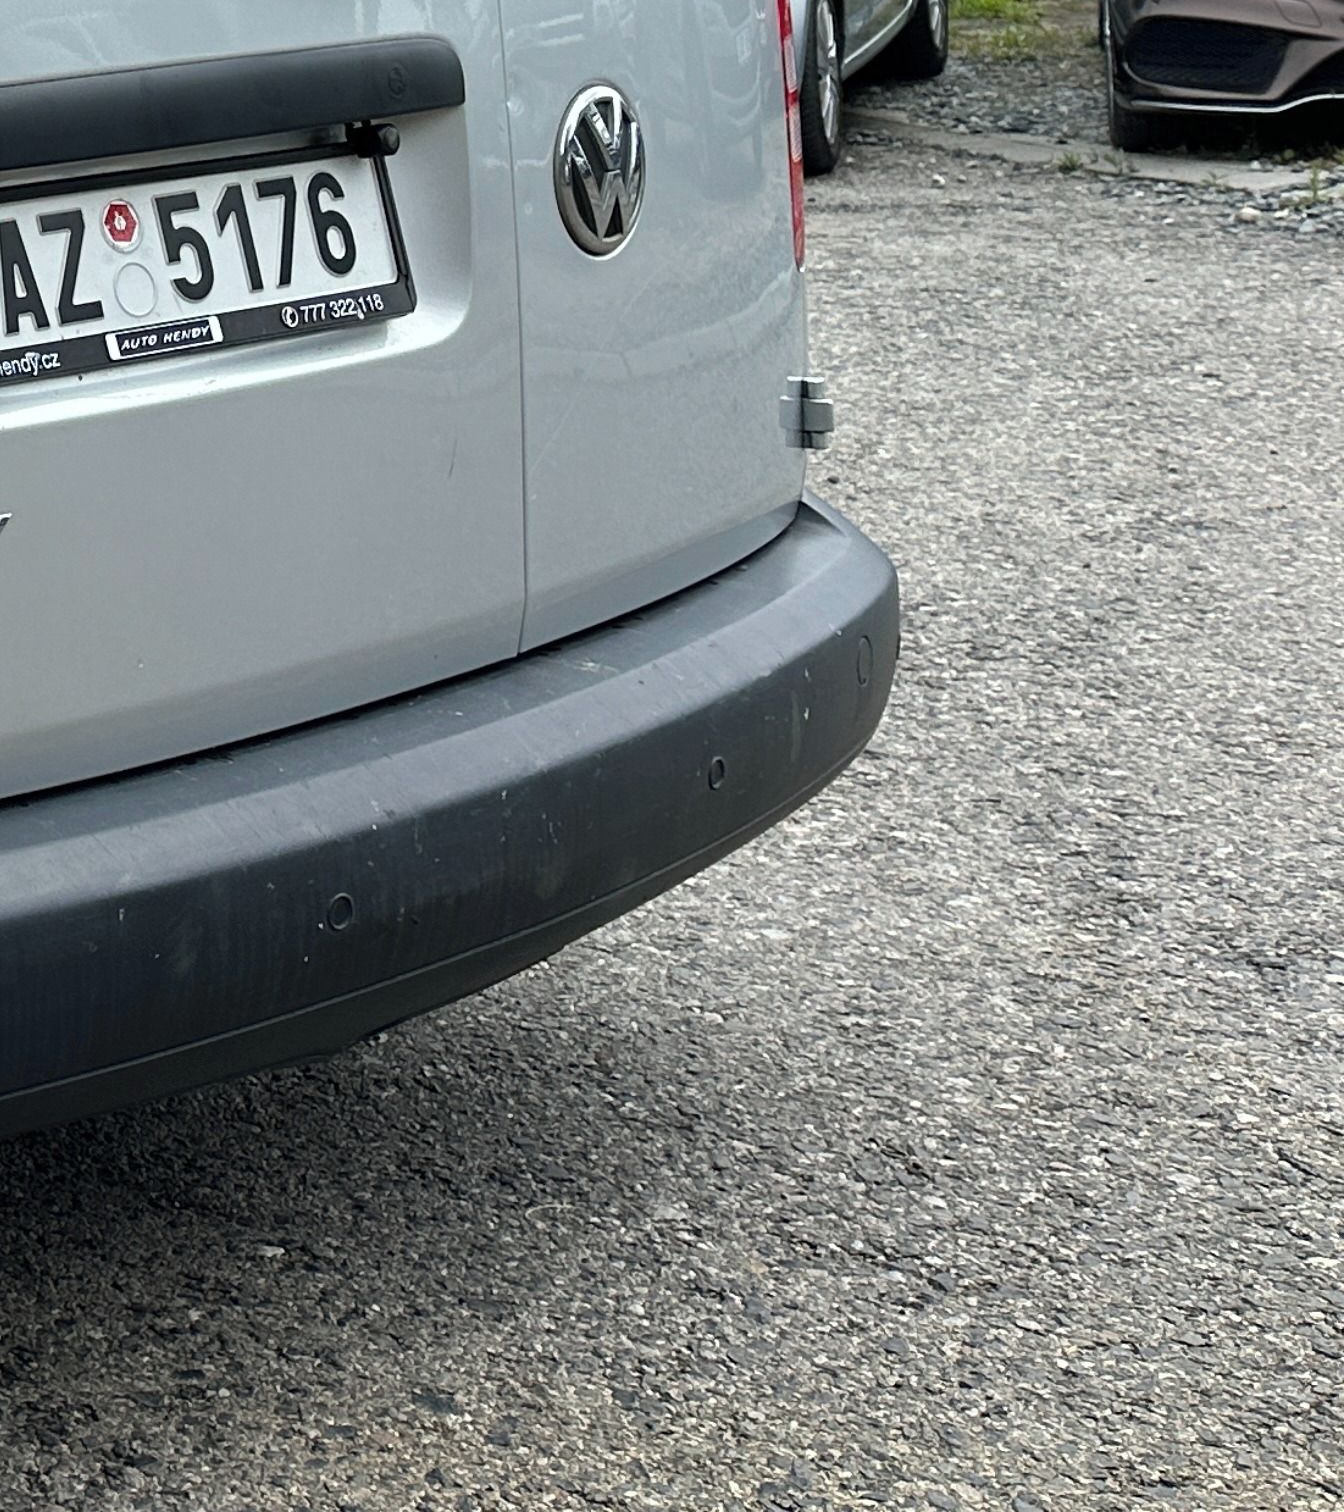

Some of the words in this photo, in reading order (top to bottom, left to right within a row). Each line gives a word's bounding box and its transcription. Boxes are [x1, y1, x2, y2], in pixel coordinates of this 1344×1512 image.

[154, 171, 357, 303] 5176
[300, 303, 326, 323] 777
[329, 299, 356, 317] 322
[358, 294, 384, 312] 118
[121, 334, 157, 351] AUTO
[163, 325, 210, 343] HENDY
